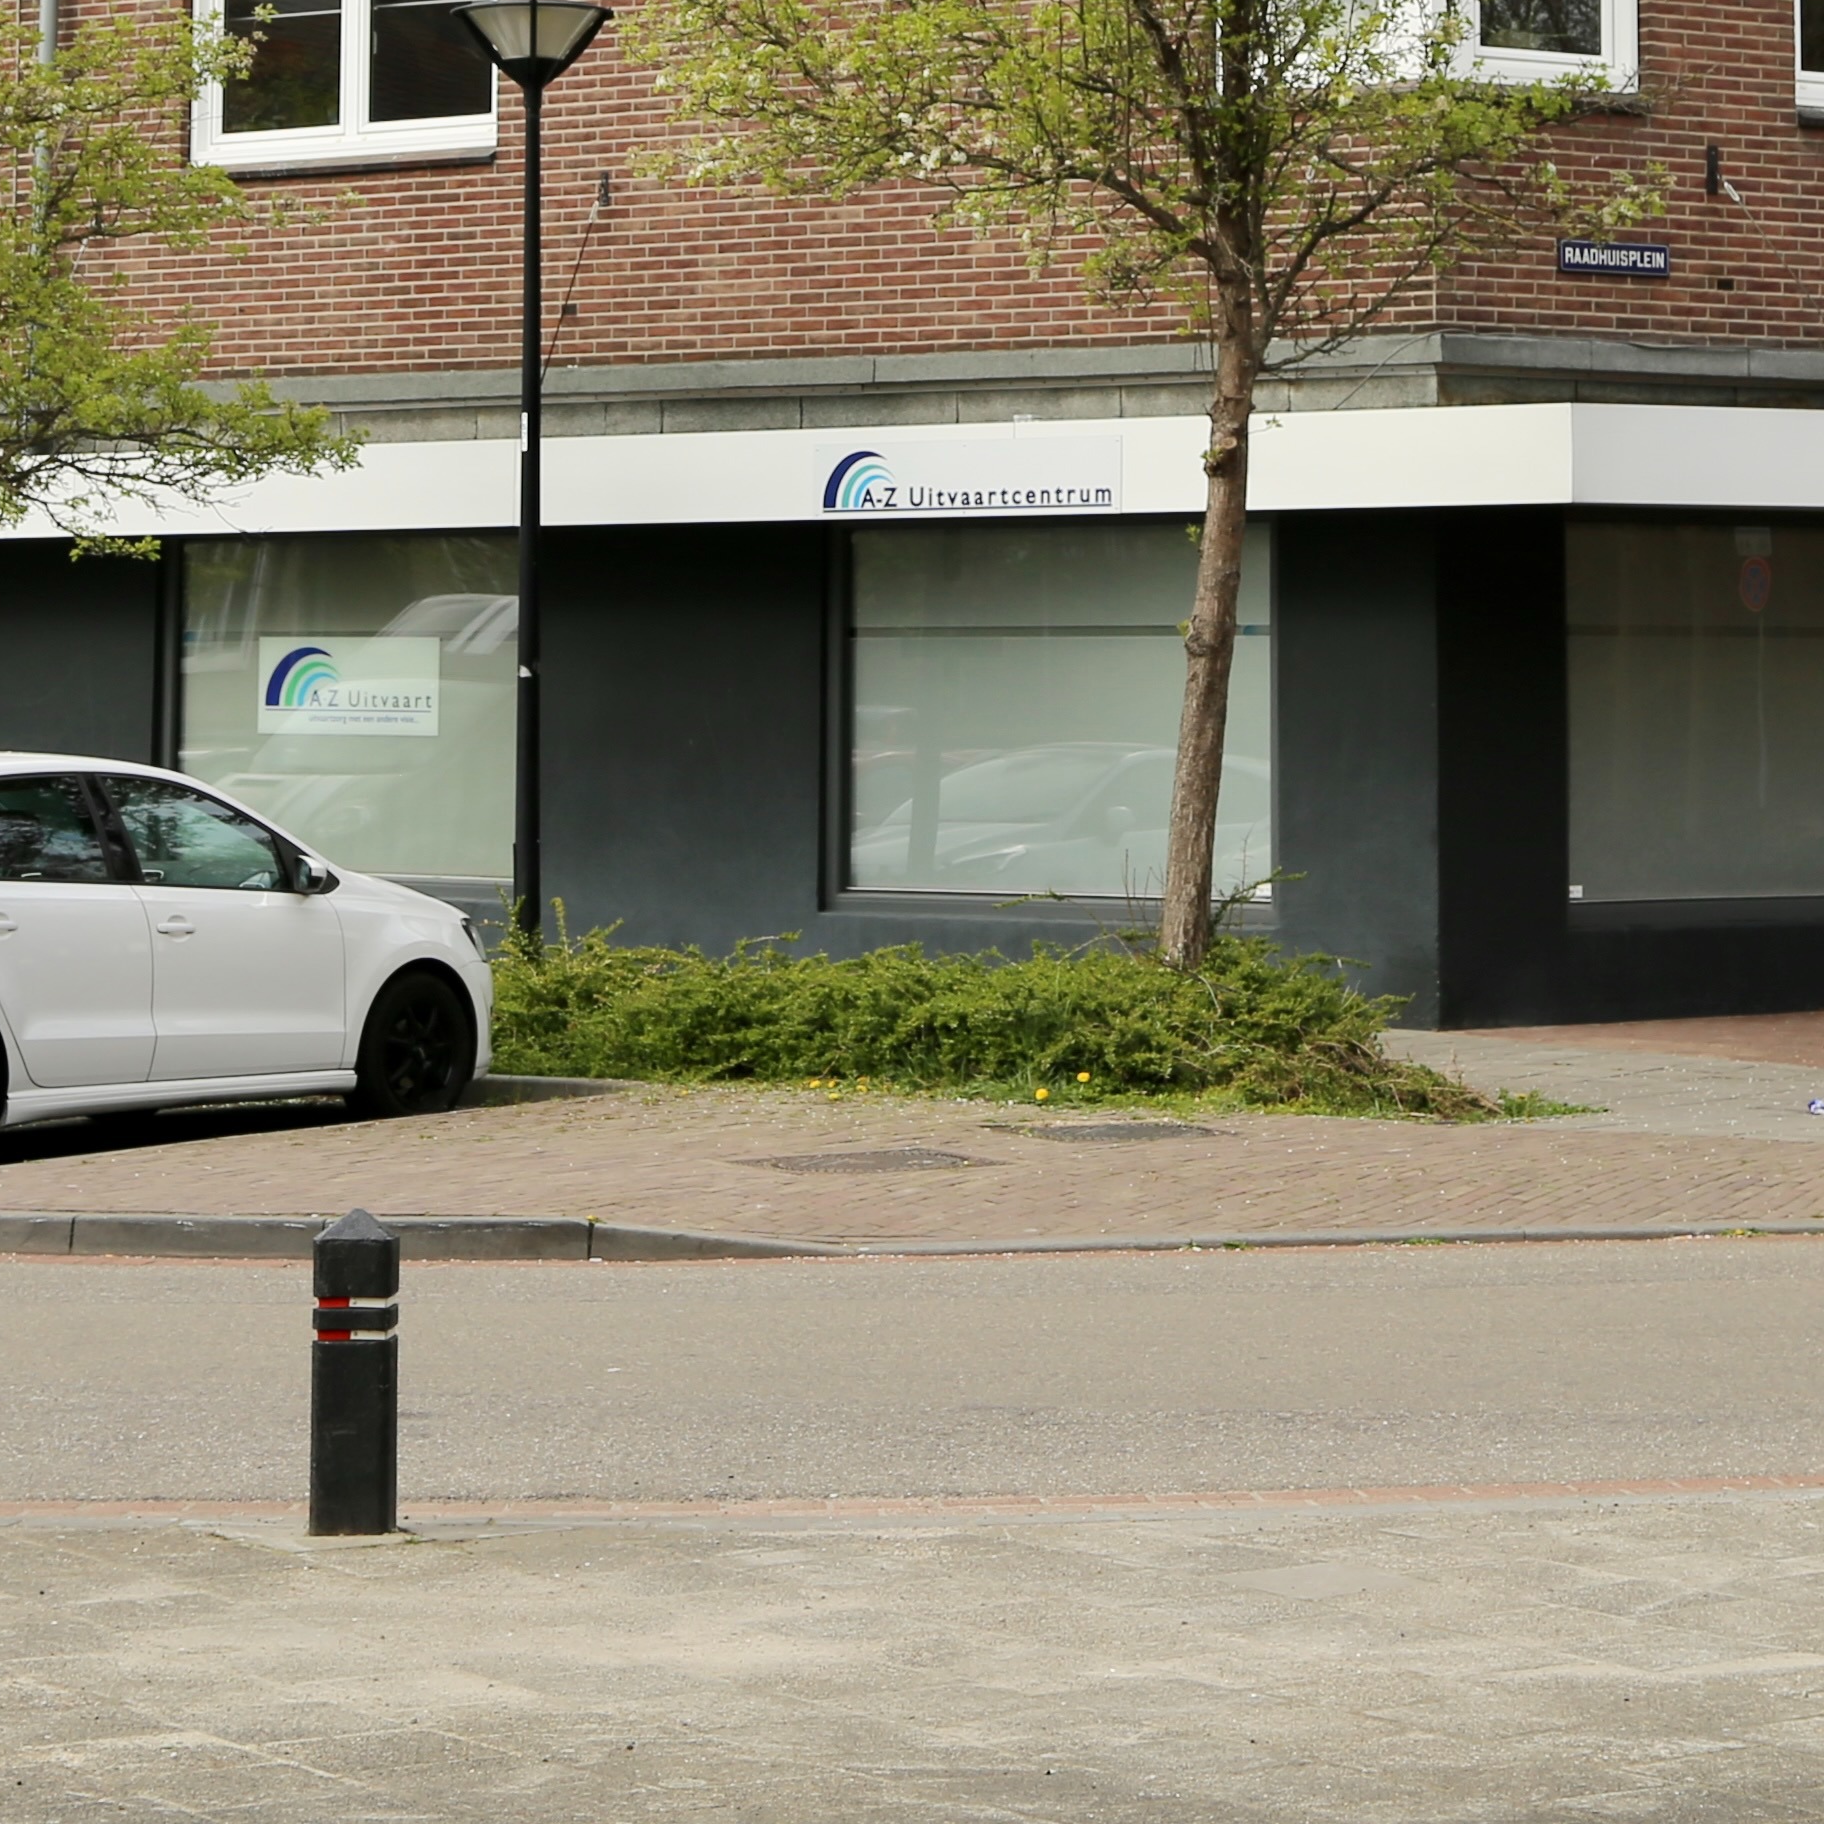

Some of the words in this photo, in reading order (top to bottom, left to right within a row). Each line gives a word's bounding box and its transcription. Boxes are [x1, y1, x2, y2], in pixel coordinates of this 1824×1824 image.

[1565, 247, 1665, 269] RAADHUISPLEIN
[860, 487, 898, 508] A-Z
[909, 486, 1113, 507] Uitvaartcentrum
[348, 690, 432, 709] Uitvaart
